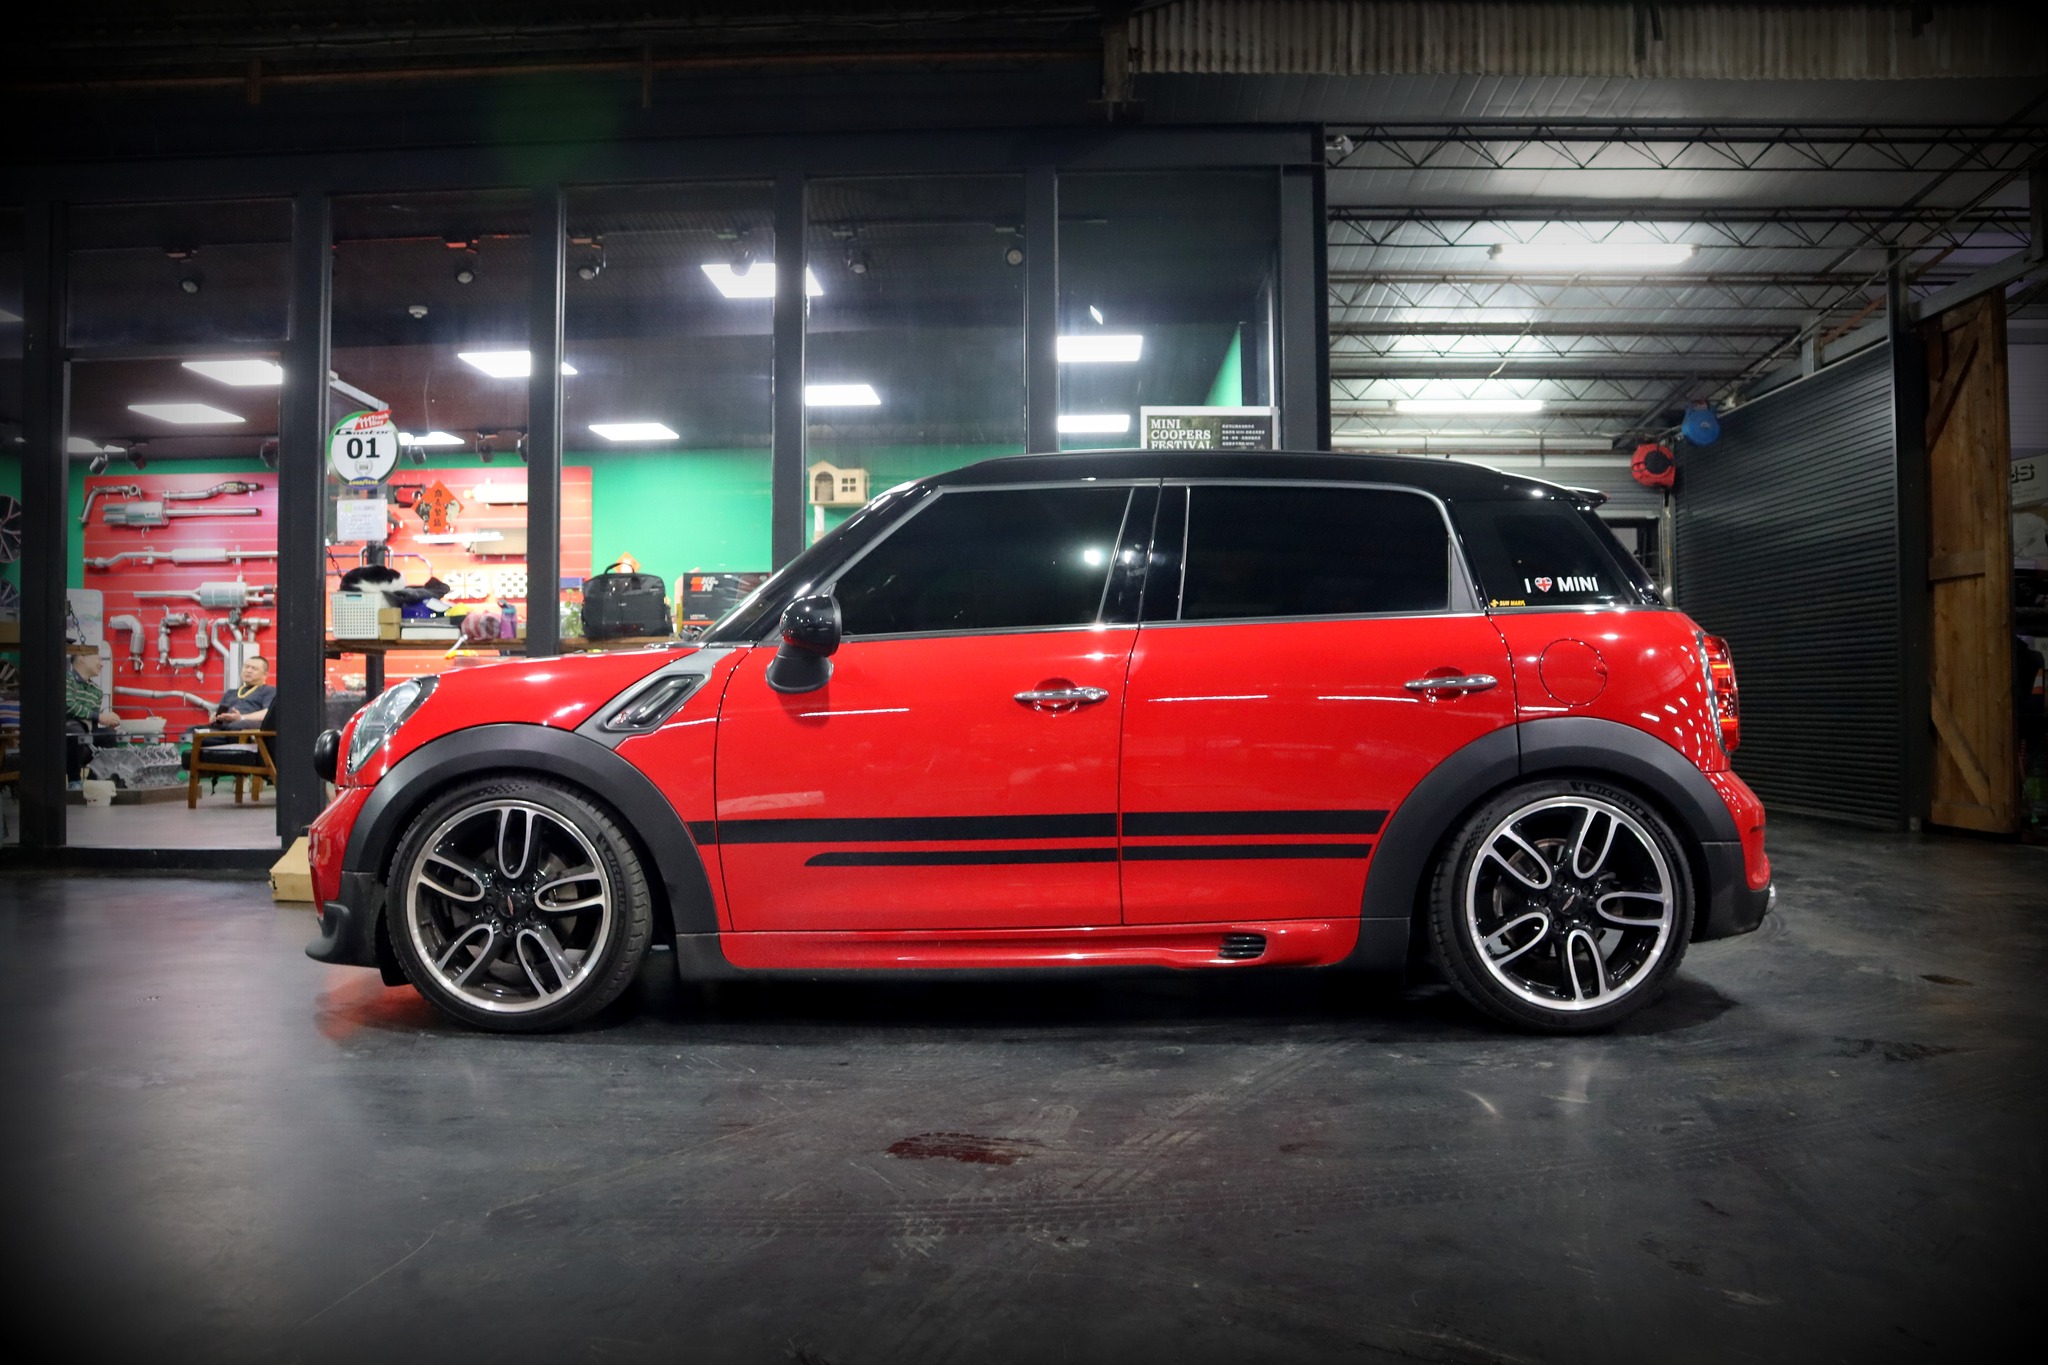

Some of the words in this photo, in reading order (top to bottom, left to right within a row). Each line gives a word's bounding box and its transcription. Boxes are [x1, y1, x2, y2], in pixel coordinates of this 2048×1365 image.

[1151, 419, 1181, 430] MINI
[1151, 430, 1211, 440] COOPERS
[346, 437, 380, 460] 01
[1151, 440, 1214, 449] FESTIVAL
[1524, 578, 1532, 594] I
[1557, 576, 1599, 592] MINI
